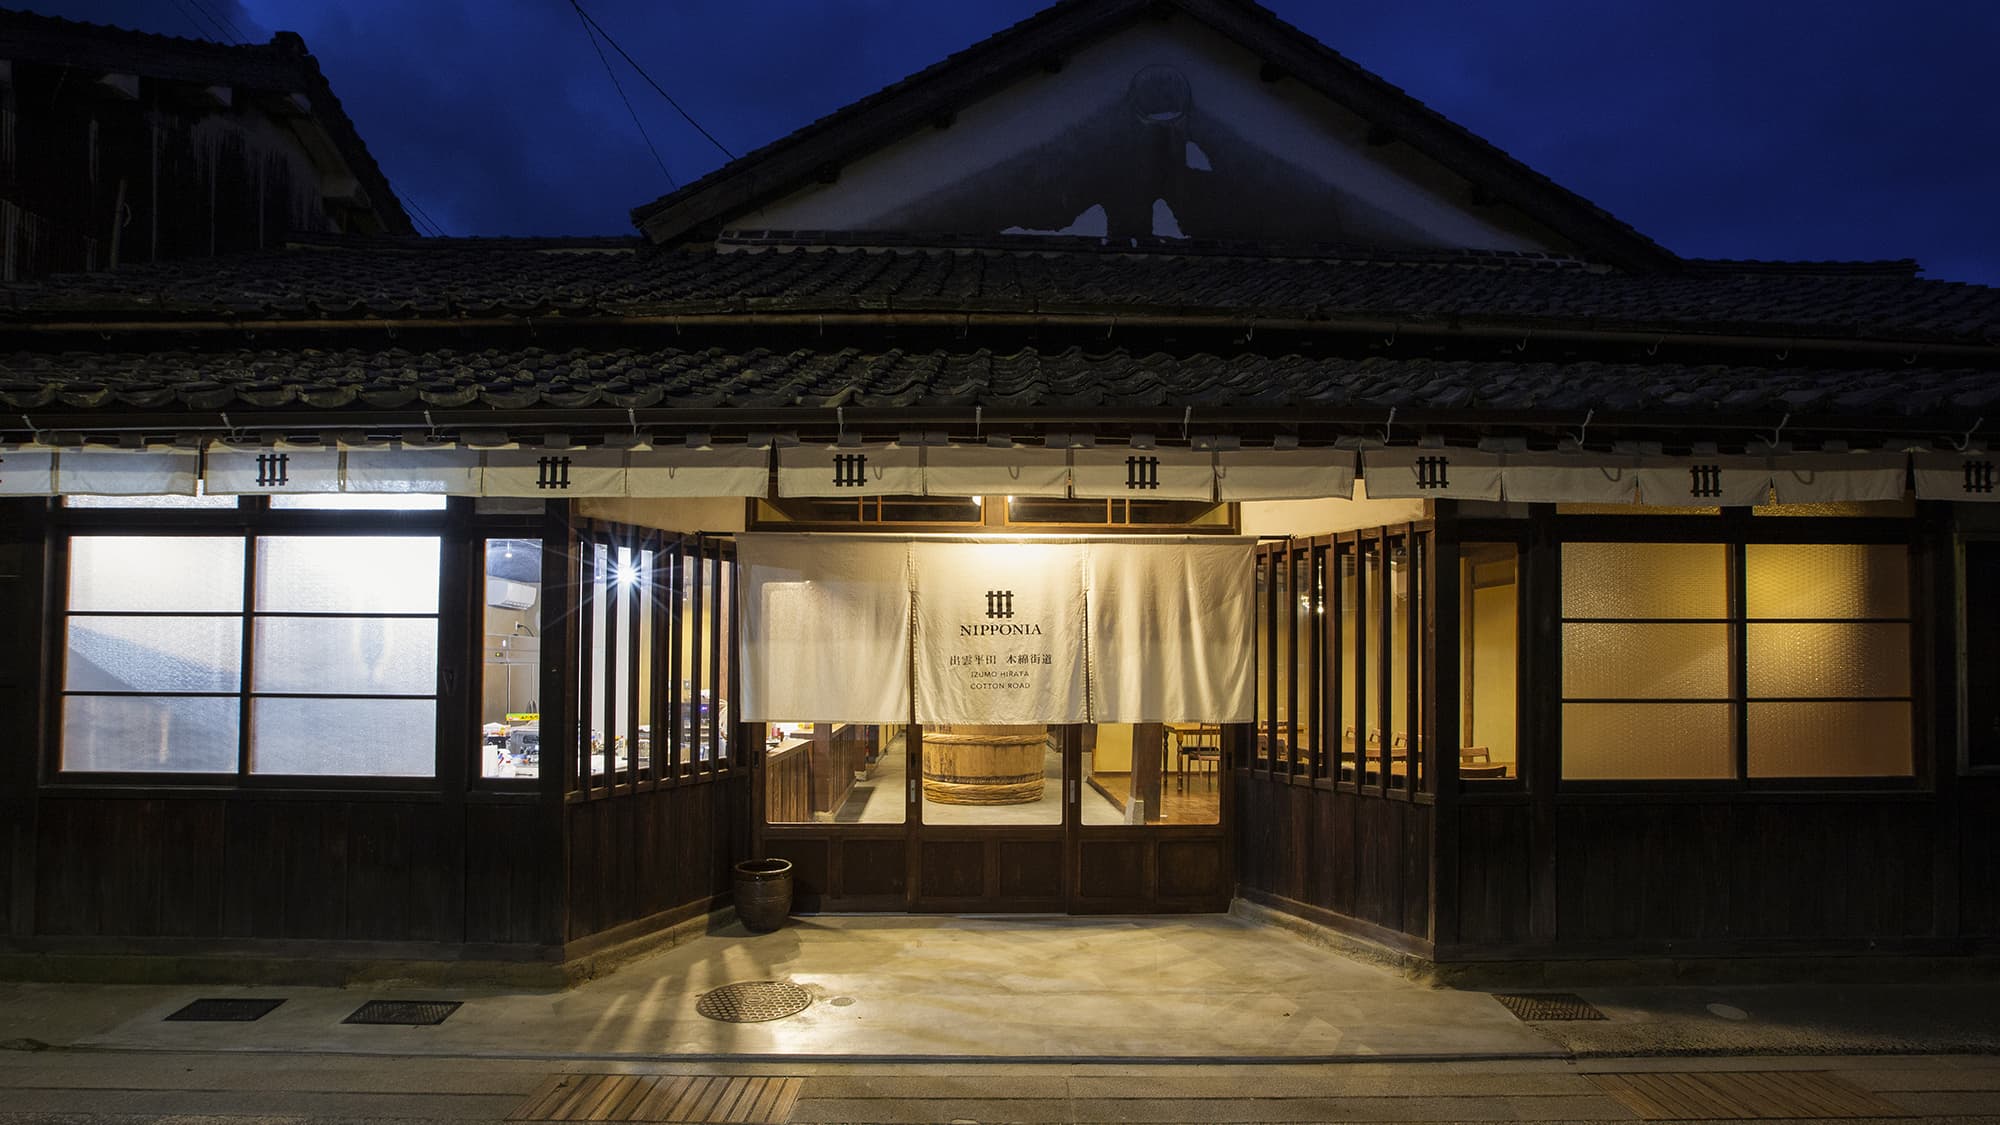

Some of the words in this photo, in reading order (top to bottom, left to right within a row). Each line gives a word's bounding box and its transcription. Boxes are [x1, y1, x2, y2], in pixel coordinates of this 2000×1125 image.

[960, 624, 1042, 636] NIPPONIA
[949, 655, 997, 666] 出雲平田
[1006, 653, 1052, 665] 木綿街道
[970, 682, 1005, 690] COTTON
